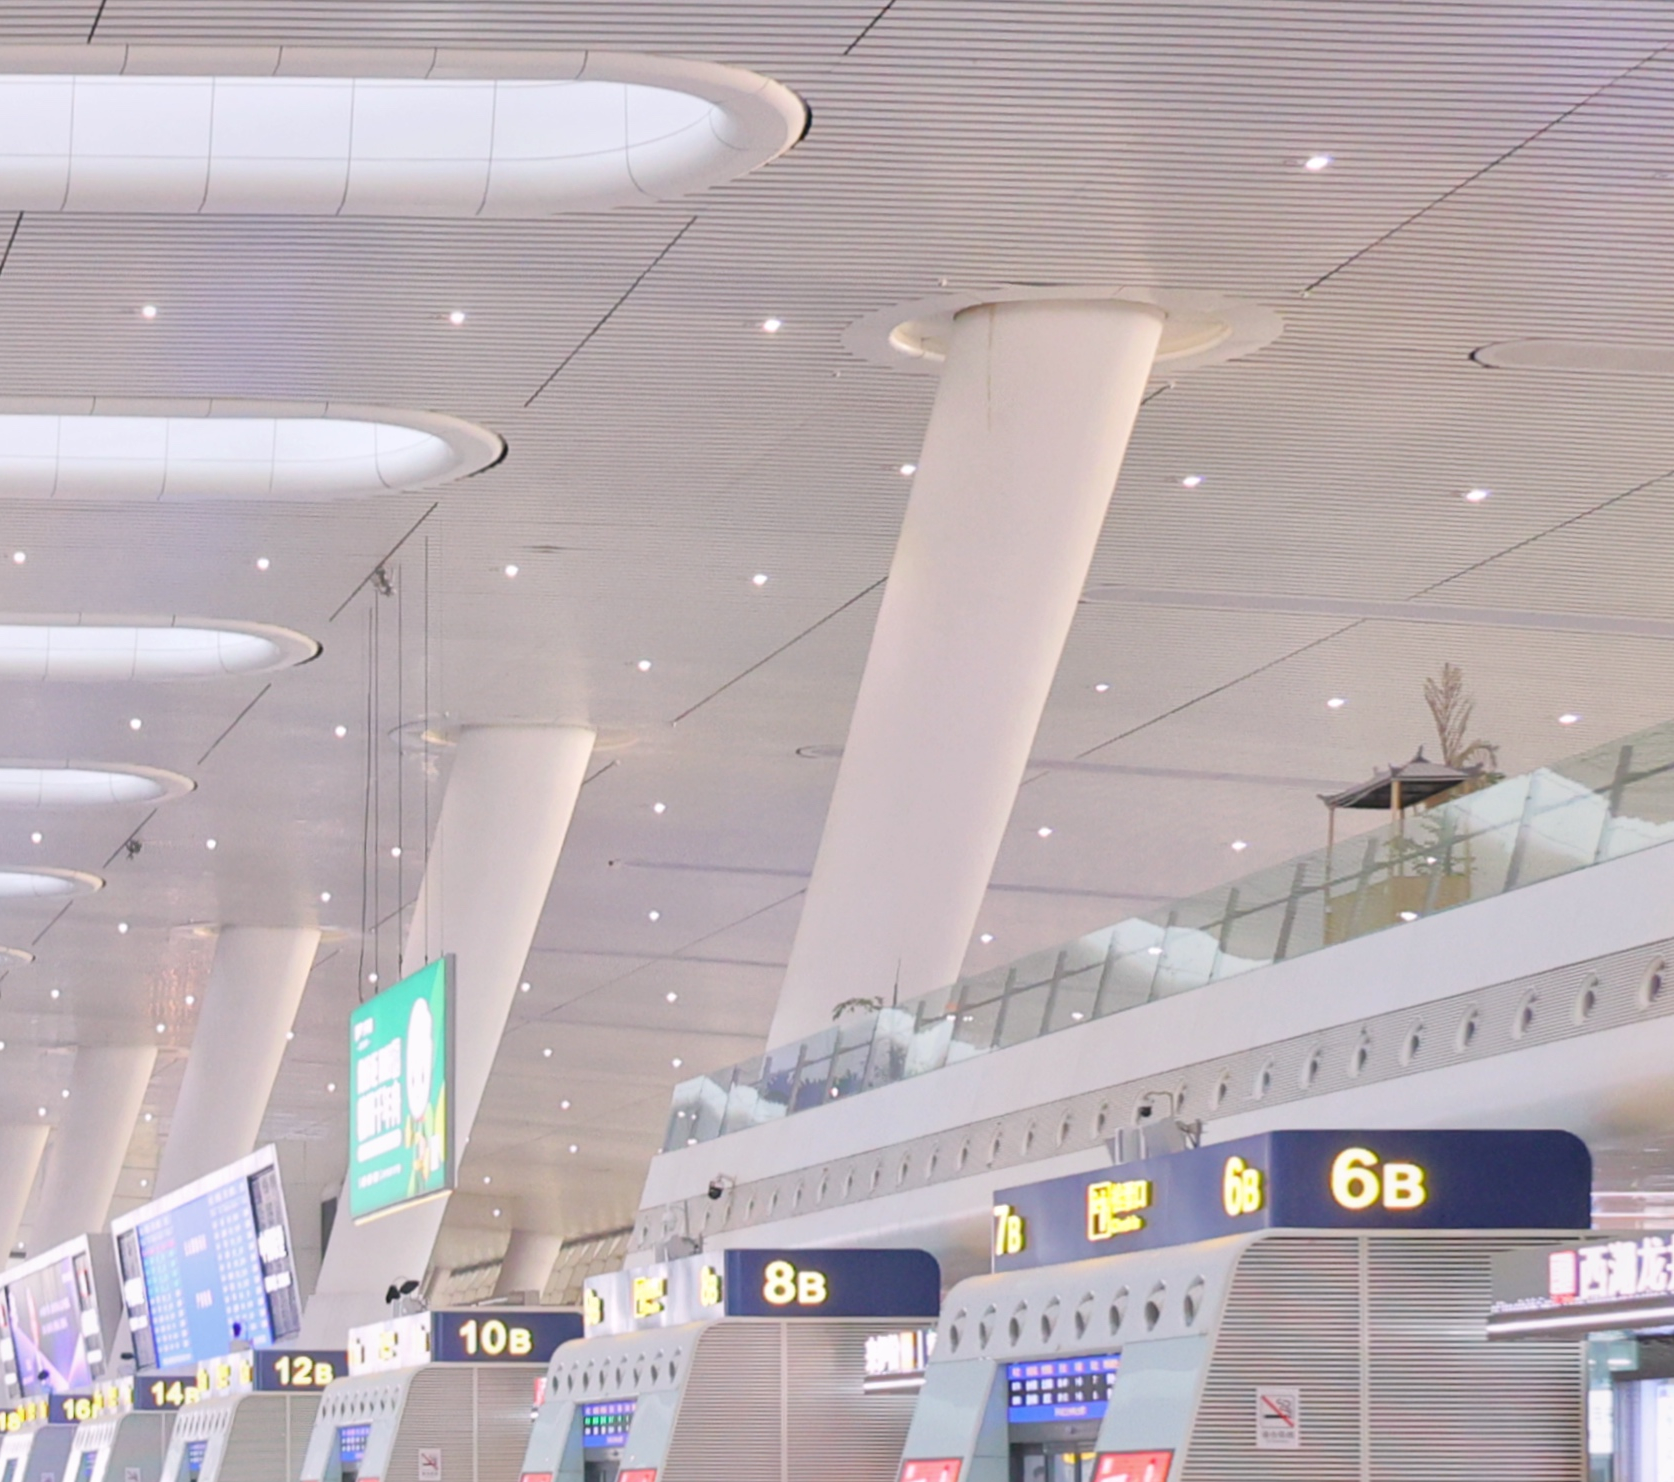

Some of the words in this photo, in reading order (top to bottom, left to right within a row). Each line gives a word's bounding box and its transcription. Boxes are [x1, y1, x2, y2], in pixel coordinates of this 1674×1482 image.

[1223, 1156, 1261, 1216] 6B
[1331, 1147, 1426, 1210] 6B
[992, 1204, 1023, 1256] 7B
[763, 1260, 828, 1306] 8B
[459, 1319, 532, 1354] 10B
[275, 1356, 334, 1387] 12B
